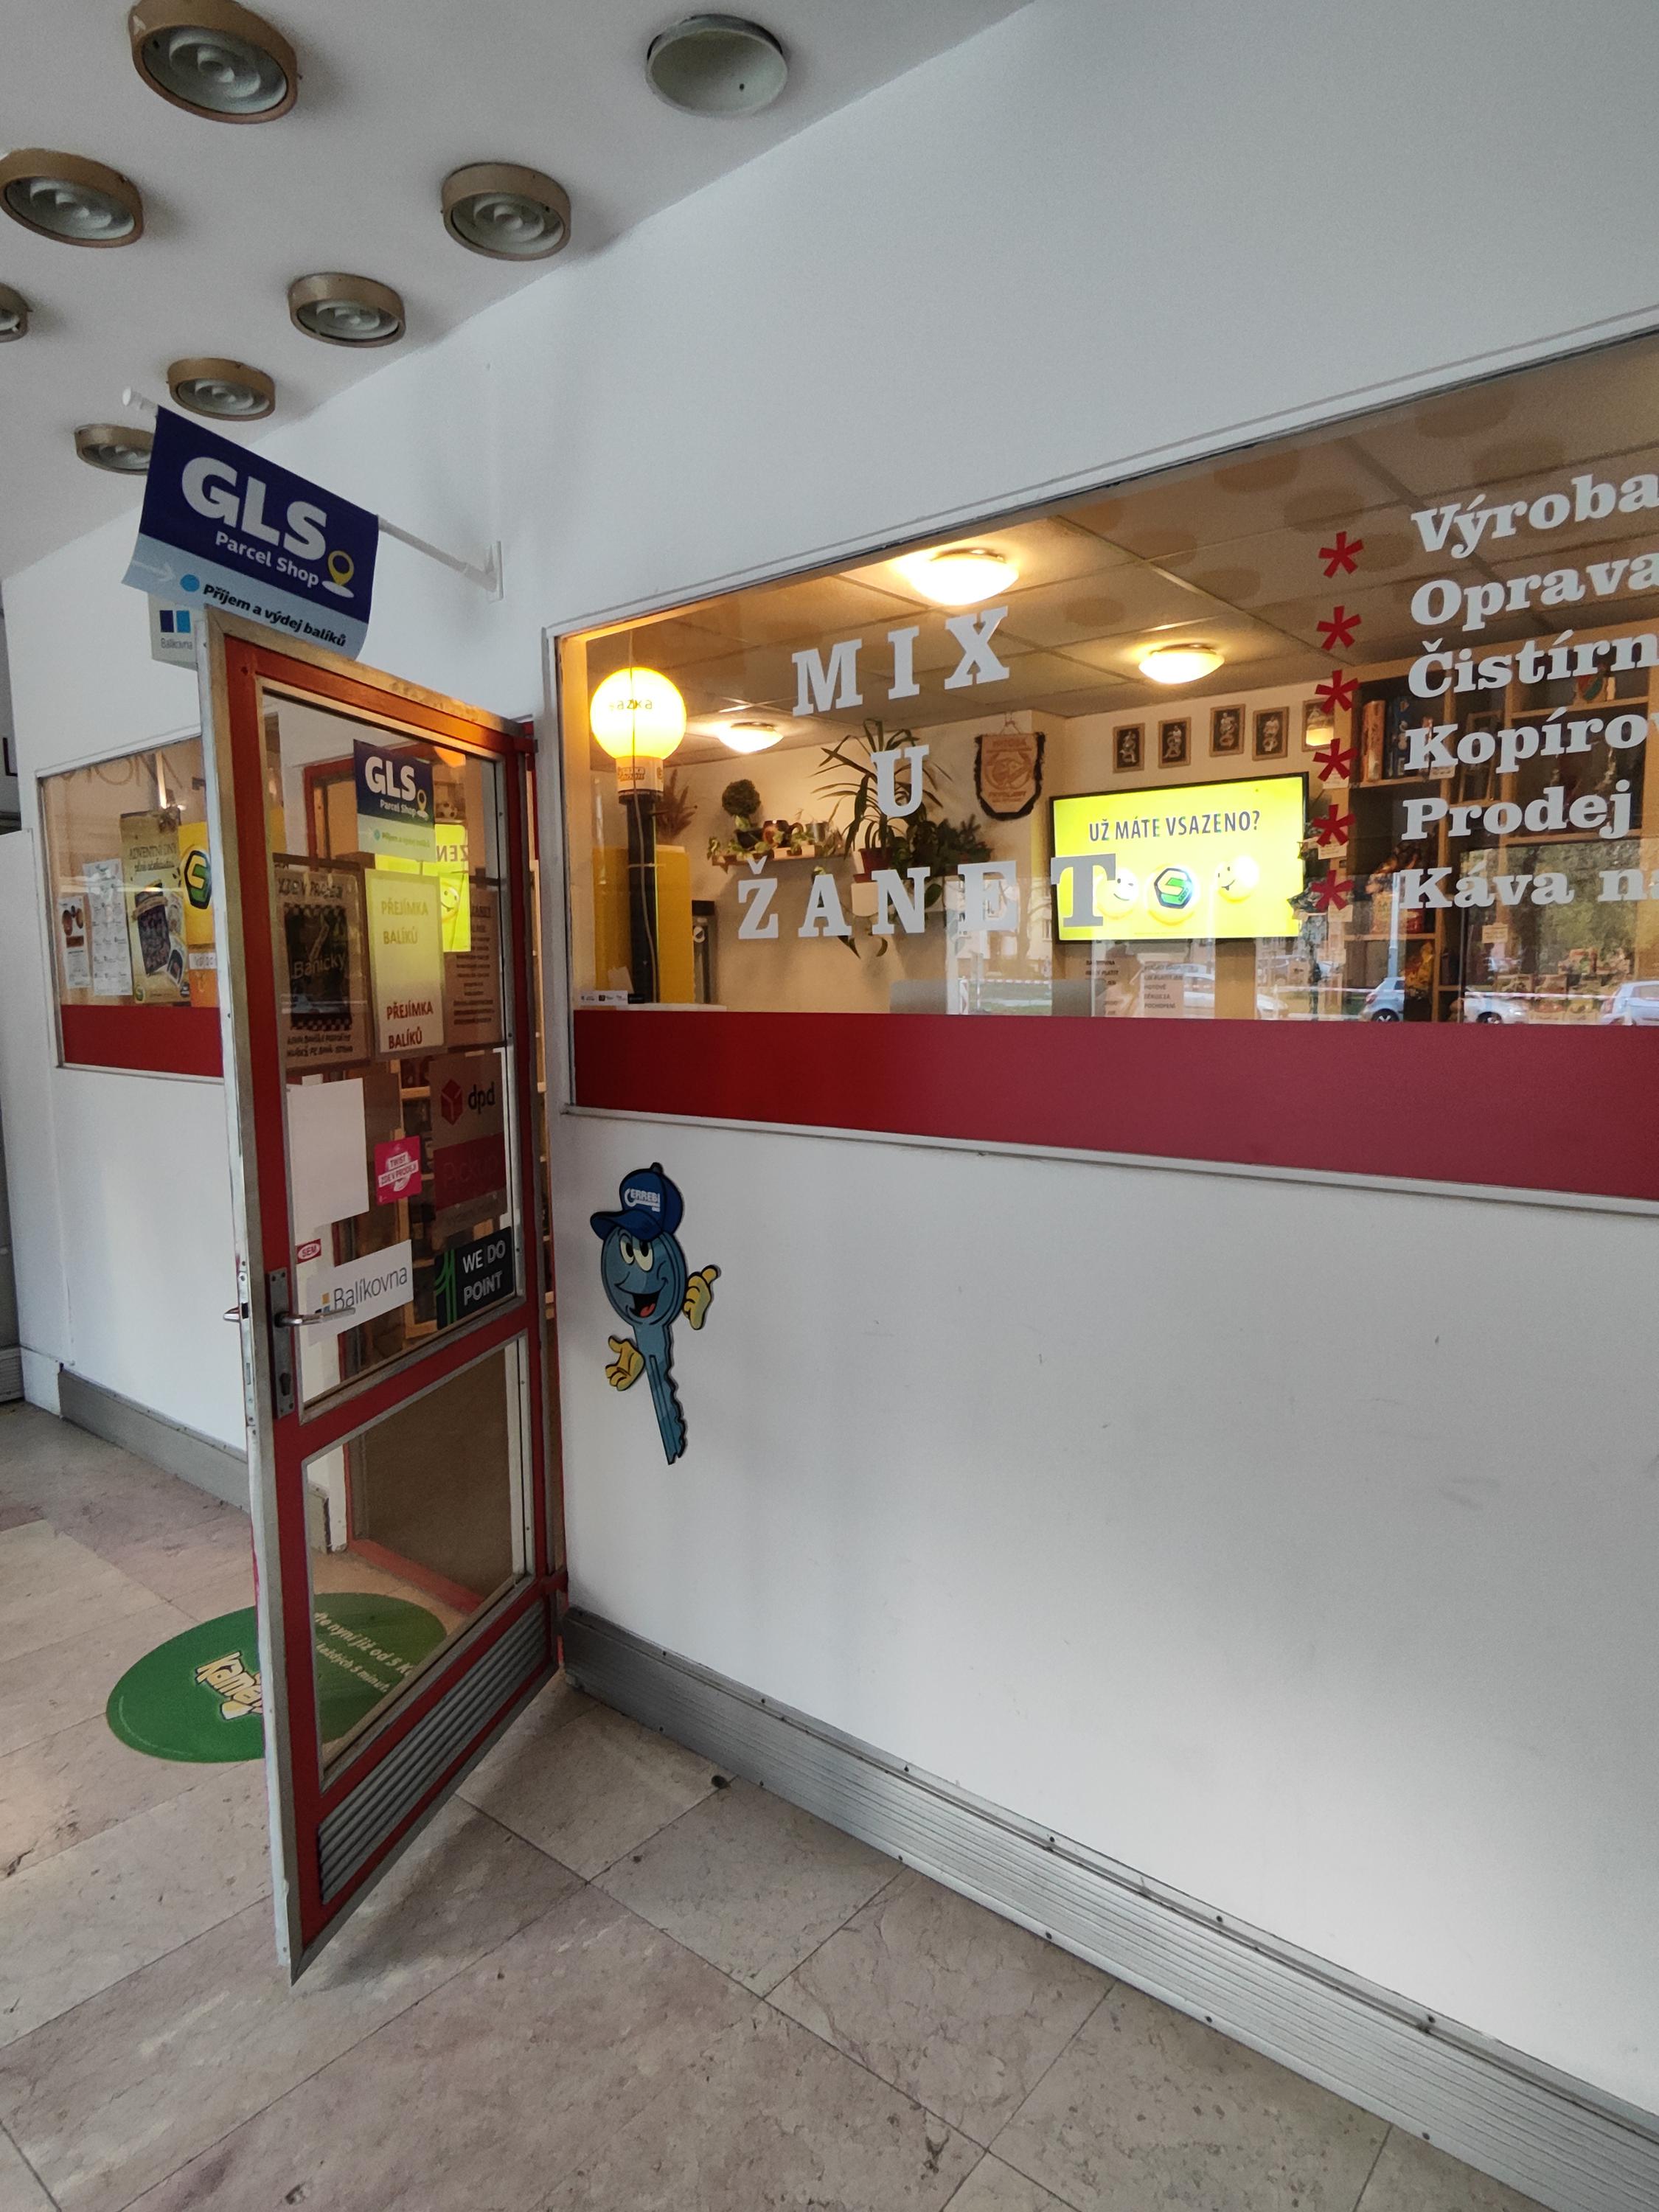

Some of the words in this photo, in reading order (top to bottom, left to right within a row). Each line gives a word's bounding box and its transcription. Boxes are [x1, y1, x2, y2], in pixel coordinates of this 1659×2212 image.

[182, 456, 327, 561] GLS
[1411, 474, 1659, 558] Výroba
[215, 531, 271, 567] Parcel
[276, 557, 319, 588] Shop
[203, 584, 251, 611] Příjem
[252, 605, 262, 616] a
[265, 610, 303, 633] výdej
[303, 622, 347, 647] balíků
[1411, 553, 1659, 632] Oprava
[791, 606, 1009, 717] MIX
[1408, 629, 1659, 698] Čistírn
[1403, 706, 1659, 774] Kopíro
[365, 756, 416, 801] GLS
[871, 745, 929, 818] U
[380, 799, 400, 813] Parcel
[1089, 819, 1110, 841] UŽ
[1115, 816, 1161, 840] MÁTE
[1166, 810, 1260, 836] VSAZENO?
[1401, 779, 1631, 840] Prodej
[381, 897, 428, 916] PŘEJÍMKA
[738, 854, 1116, 939] ŽANET
[1399, 861, 1575, 909] Káva
[1597, 869, 1659, 902] n
[386, 1000, 434, 1020] PŘEJÍMKA
[388, 1026, 422, 1050] BALÍKŮ
[467, 1081, 495, 1114] dpd
[462, 1249, 483, 1274] WE
[487, 1240, 506, 1264] DO
[333, 1267, 408, 1310] Balíkovna
[464, 1270, 504, 1306] POINT
[369, 1649, 394, 1661] od
